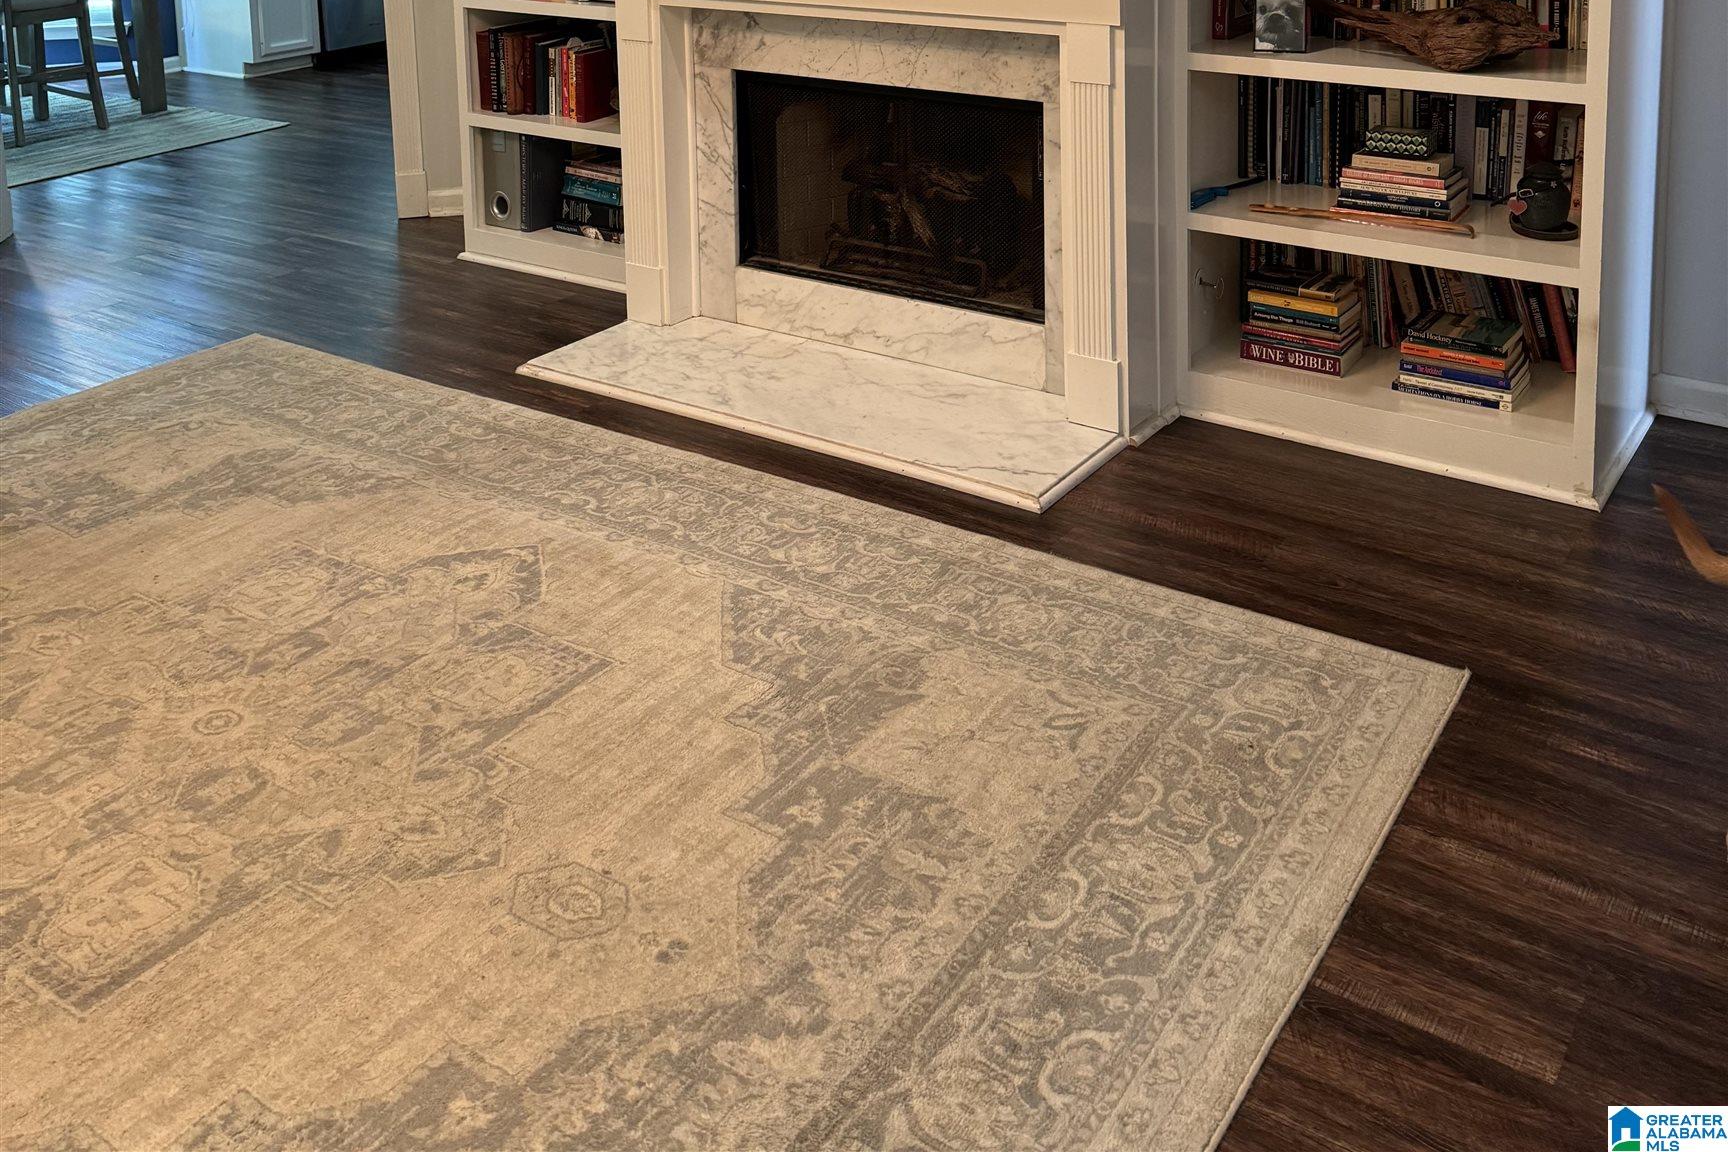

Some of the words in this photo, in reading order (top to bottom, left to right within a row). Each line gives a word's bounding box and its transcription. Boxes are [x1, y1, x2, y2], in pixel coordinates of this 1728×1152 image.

[1408, 329, 1426, 339] David
[1426, 333, 1452, 344] Hockney
[1251, 344, 1284, 363] WINE
[1294, 353, 1334, 372] BIBLE
